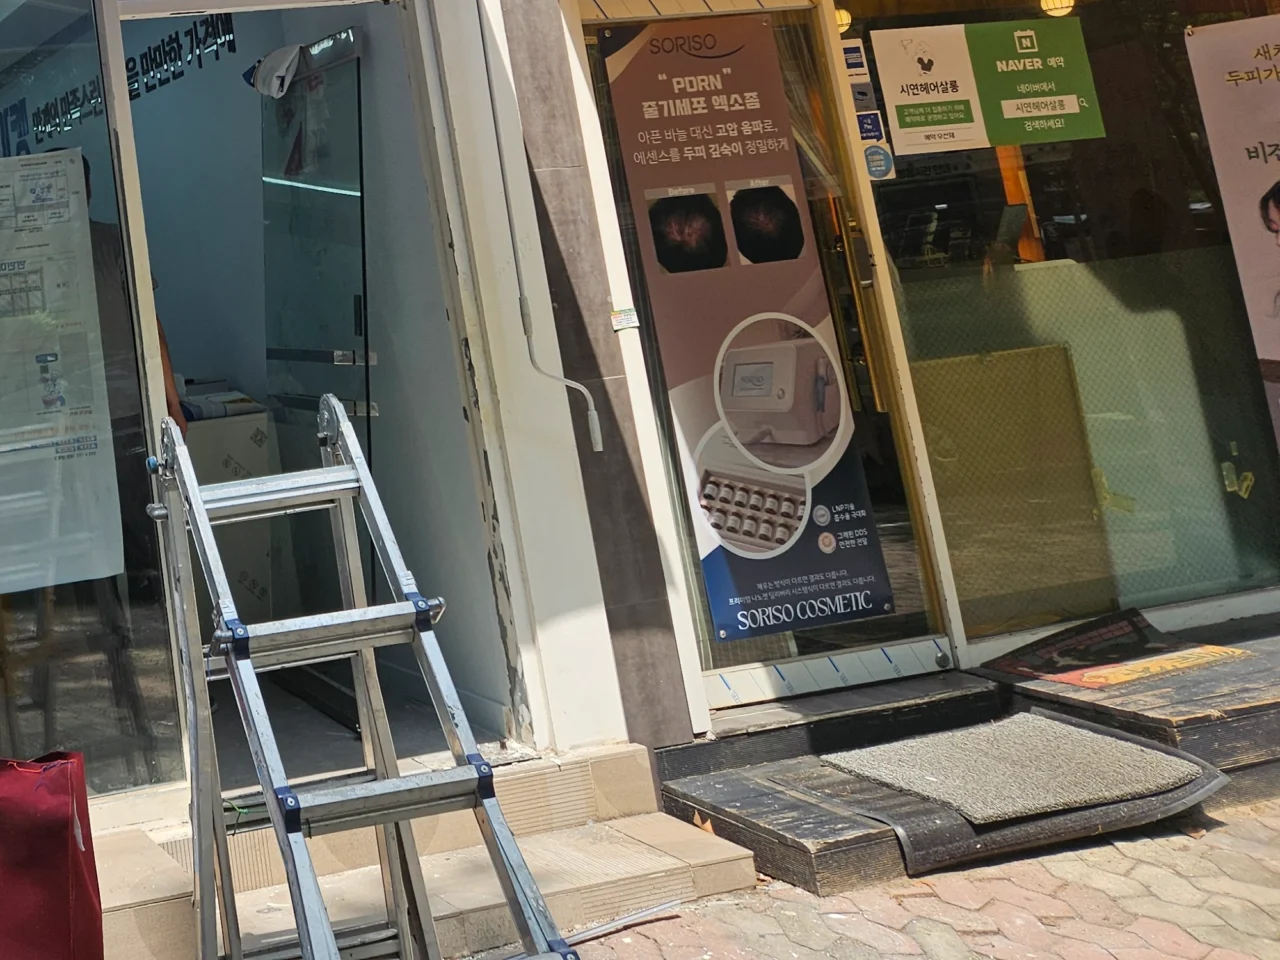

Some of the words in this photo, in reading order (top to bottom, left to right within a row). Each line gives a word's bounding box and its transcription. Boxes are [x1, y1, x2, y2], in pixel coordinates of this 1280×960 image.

[649, 33, 745, 59] SORISO
[140, 31, 184, 93] 만만한
[996, 58, 1043, 72] NAVER
[1046, 56, 1065, 68] 예약
[900, 80, 959, 96] 시연헤어살롱
[1017, 81, 1056, 93] 네이버에서
[642, 96, 708, 119] 줄기세포
[712, 92, 760, 112] 엑소좀
[1016, 99, 1066, 114] 시연헤어살롱
[638, 129, 662, 145] 아픈
[665, 128, 688, 143] 바늘
[690, 124, 713, 140] 대신
[716, 122, 738, 137] 고압
[1024, 118, 1065, 131] 검색하세요!
[633, 147, 681, 165] 에센스를
[683, 145, 707, 161] 두피
[709, 141, 743, 159] 깊숙이
[745, 137, 790, 155] 정밀하게
[737, 604, 794, 630] SORISO
[796, 591, 873, 620] COSMETIC
